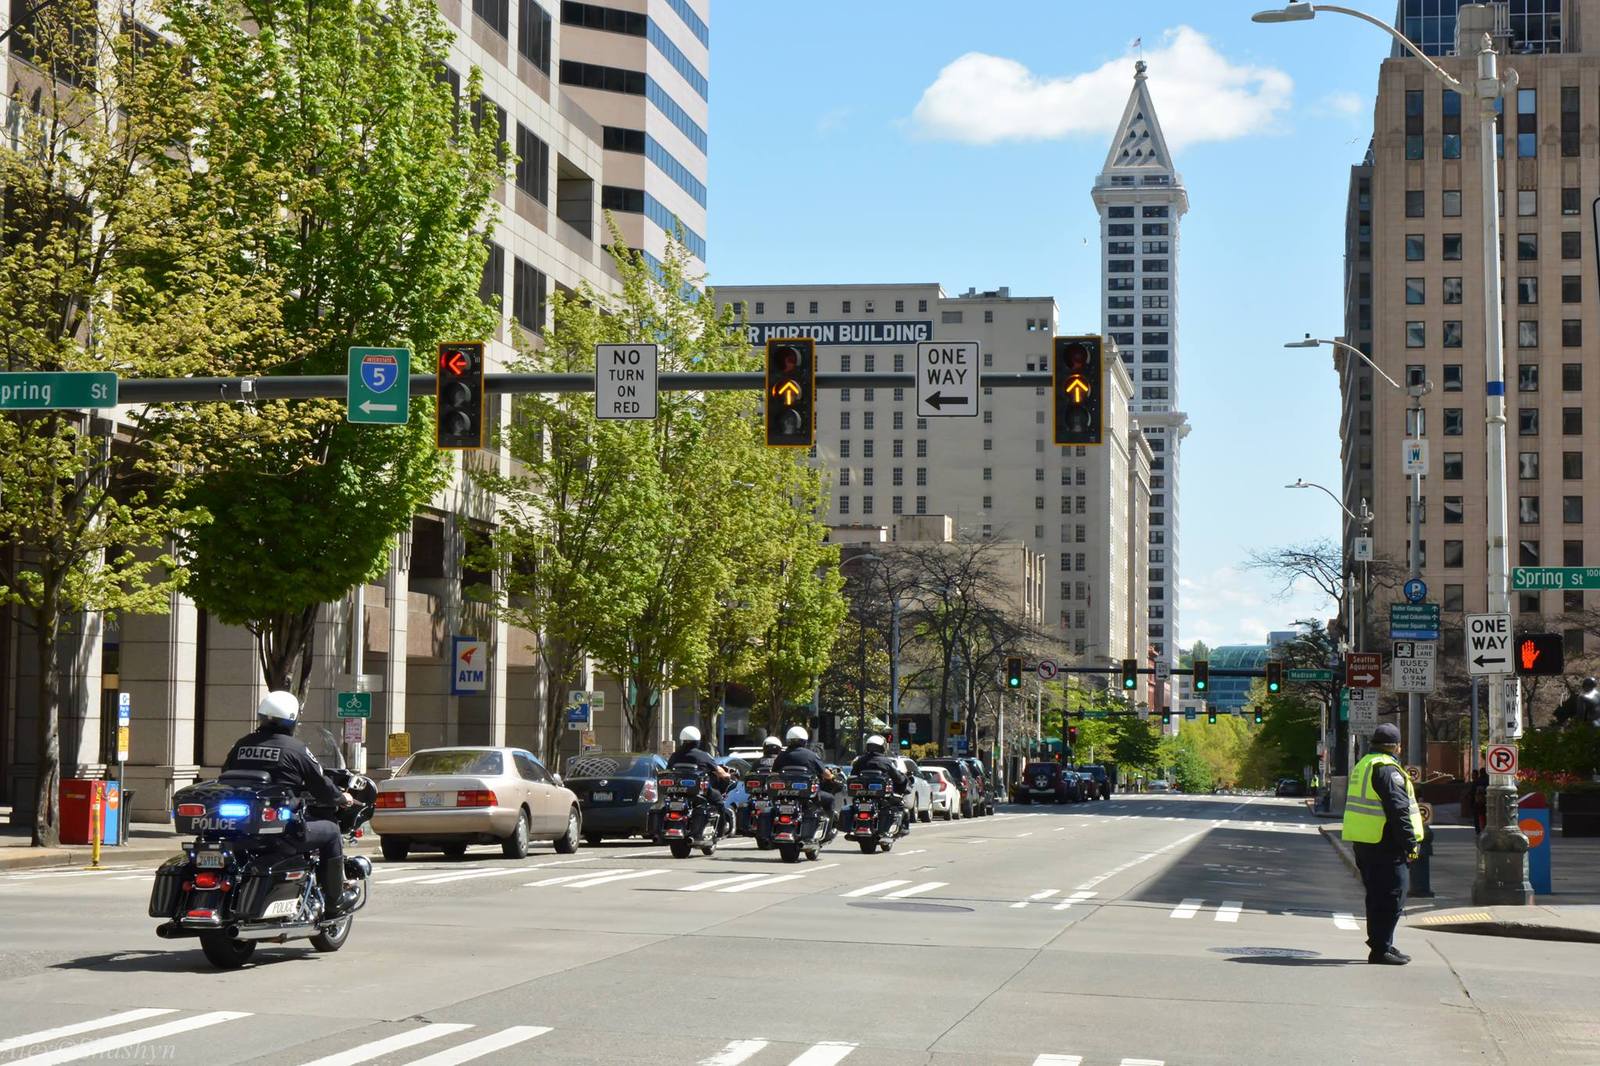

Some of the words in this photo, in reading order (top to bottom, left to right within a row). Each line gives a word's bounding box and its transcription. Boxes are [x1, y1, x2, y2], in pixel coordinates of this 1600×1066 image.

[765, 325, 834, 343] HORTON
[839, 324, 928, 342] BUILDING
[613, 350, 640, 364] NO
[928, 349, 966, 364] ONE
[373, 368, 385, 386] 5
[609, 369, 644, 381] TURN
[927, 368, 968, 385] WAY
[0, 381, 51, 405] pring
[91, 383, 108, 399] St
[617, 385, 636, 398] ON
[613, 401, 640, 414] RED
[1516, 569, 1563, 588] Spring
[1571, 573, 1583, 585] St
[1471, 619, 1507, 633] ONE
[1471, 636, 1508, 650] WAY
[1353, 655, 1376, 663] Seattle
[1400, 659, 1429, 667] BUSES
[1349, 663, 1380, 672] Aquarium
[1403, 667, 1425, 675] ONLY
[459, 670, 484, 682] ATM
[1506, 684, 1518, 697] ONE
[1506, 700, 1519, 714] WAY
[239, 747, 279, 760] POLICE
[191, 817, 237, 830] POLICE
[272, 901, 296, 914] POLICE
